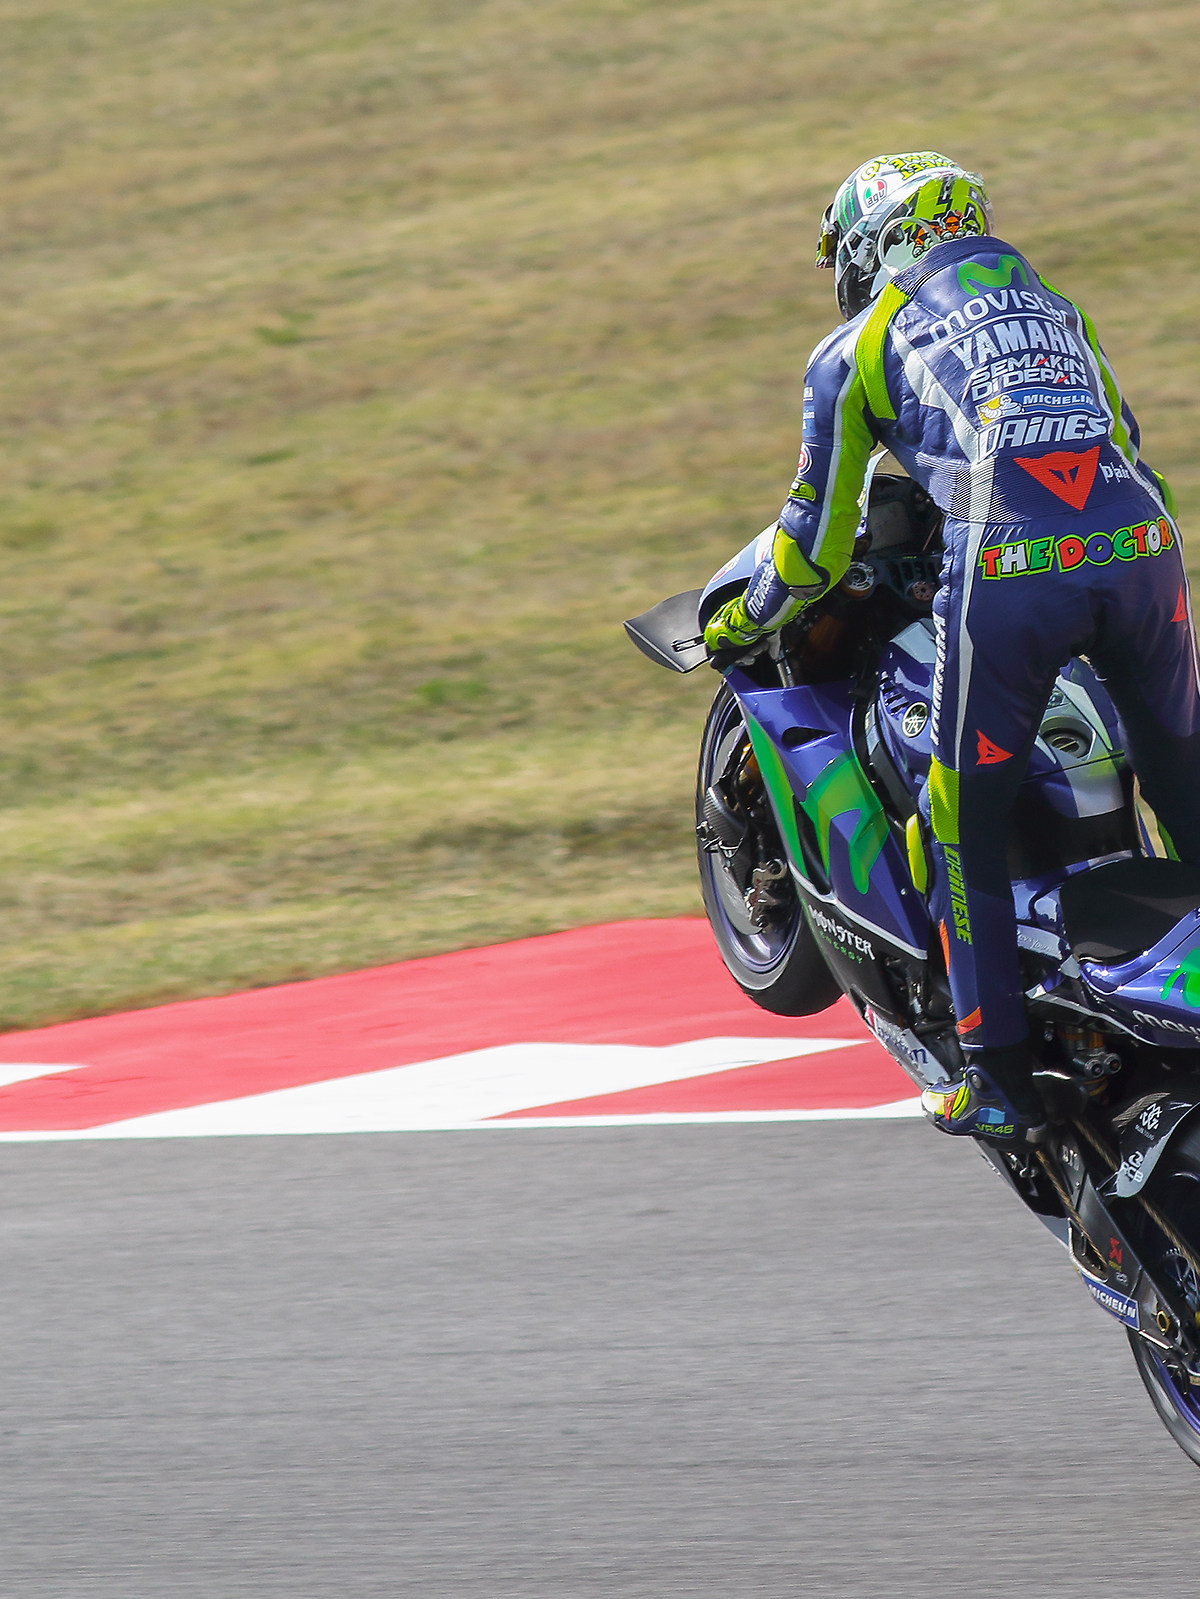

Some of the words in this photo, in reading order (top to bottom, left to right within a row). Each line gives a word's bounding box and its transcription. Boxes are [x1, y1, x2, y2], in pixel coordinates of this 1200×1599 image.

[949, 319, 1085, 371] YAMAHA
[1002, 367, 1090, 388] DEPAN
[1023, 394, 1094, 405] MICHELIN
[980, 538, 1053, 579] THE
[1057, 517, 1173, 571] DOCTOR
[808, 904, 875, 960] MONSTER
[1088, 1284, 1136, 1319] MICHELIN
